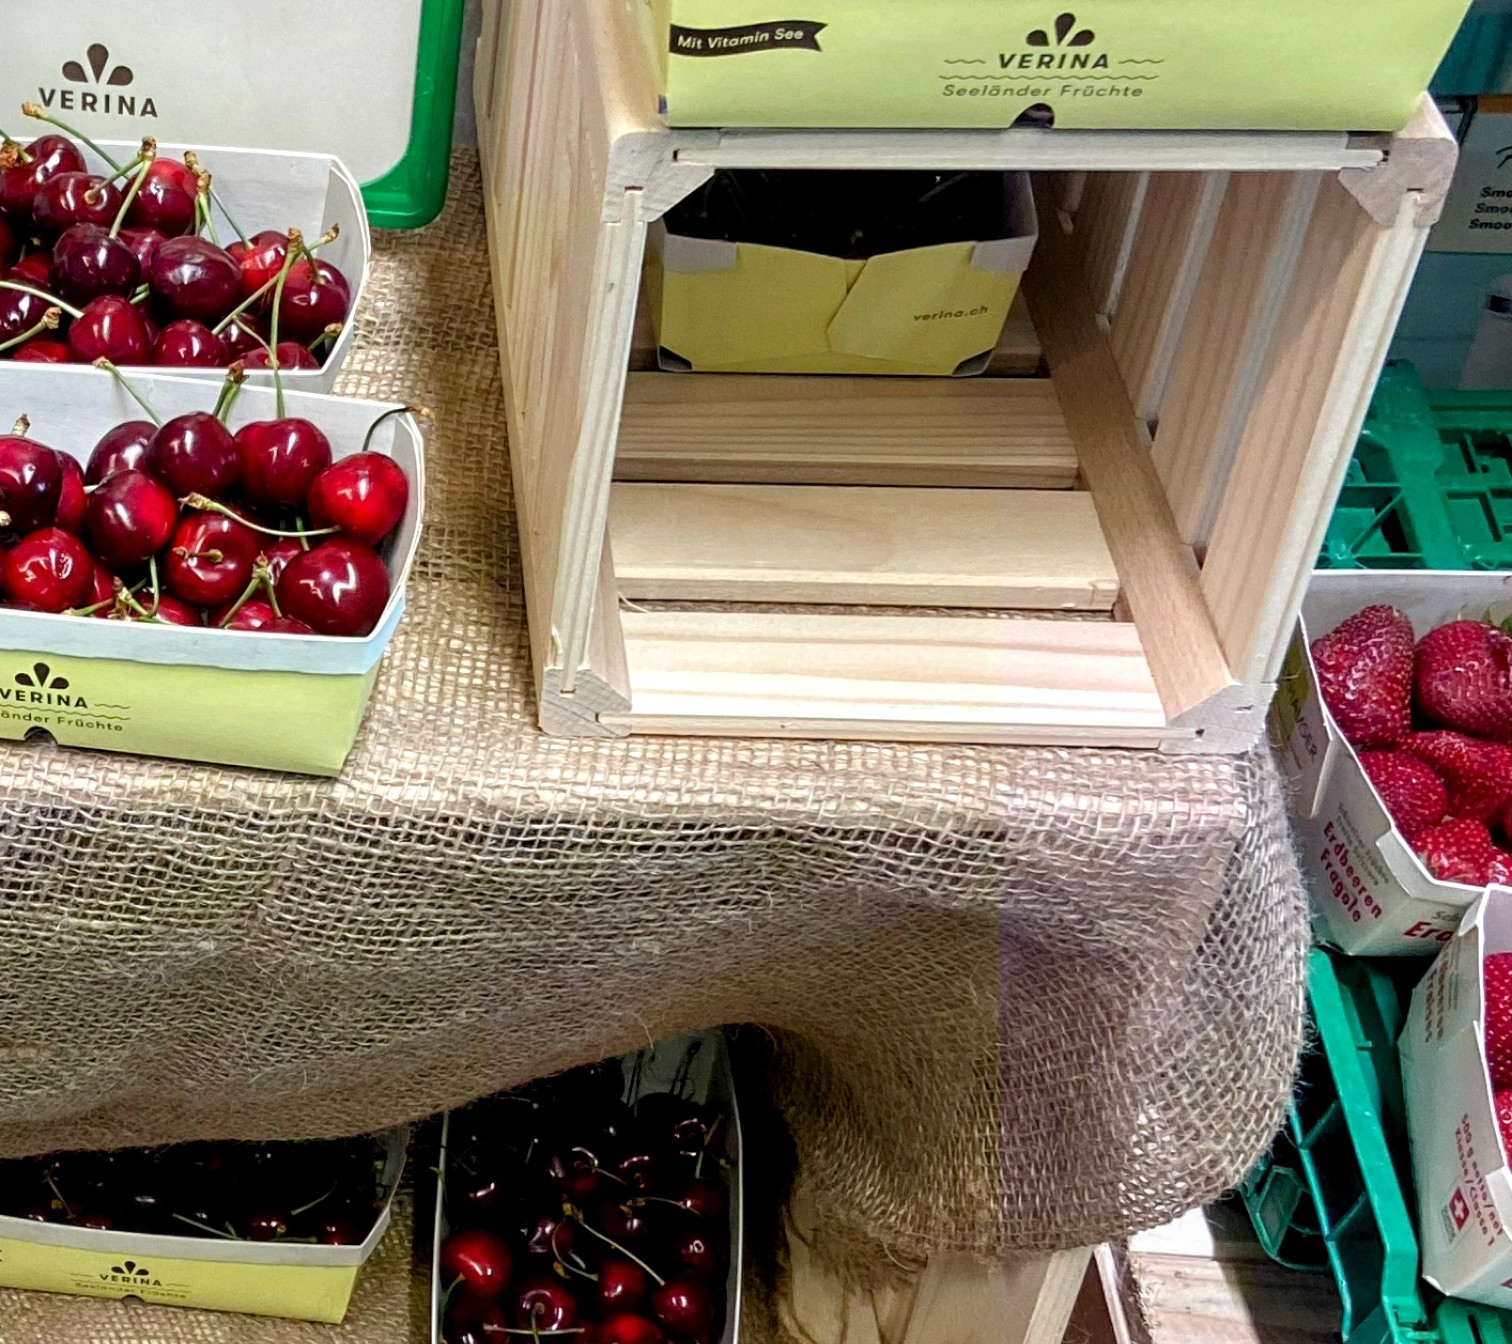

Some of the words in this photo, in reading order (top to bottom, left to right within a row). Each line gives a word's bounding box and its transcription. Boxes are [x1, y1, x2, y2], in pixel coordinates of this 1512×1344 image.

[677, 35, 702, 49] Mit
[707, 31, 770, 49] Vitamin
[774, 28, 804, 41] See
[998, 53, 1110, 69] VERINA
[942, 84, 1052, 97] Seeländer
[1060, 84, 1143, 97] Früchte
[38, 87, 158, 117] VERINA
[913, 305, 989, 321] verina.ch
[57, 716, 123, 732] Früchte
[1323, 820, 1383, 919] Erdbeeren
[1320, 847, 1362, 923] Fragole
[99, 1274, 162, 1287] VERINA
